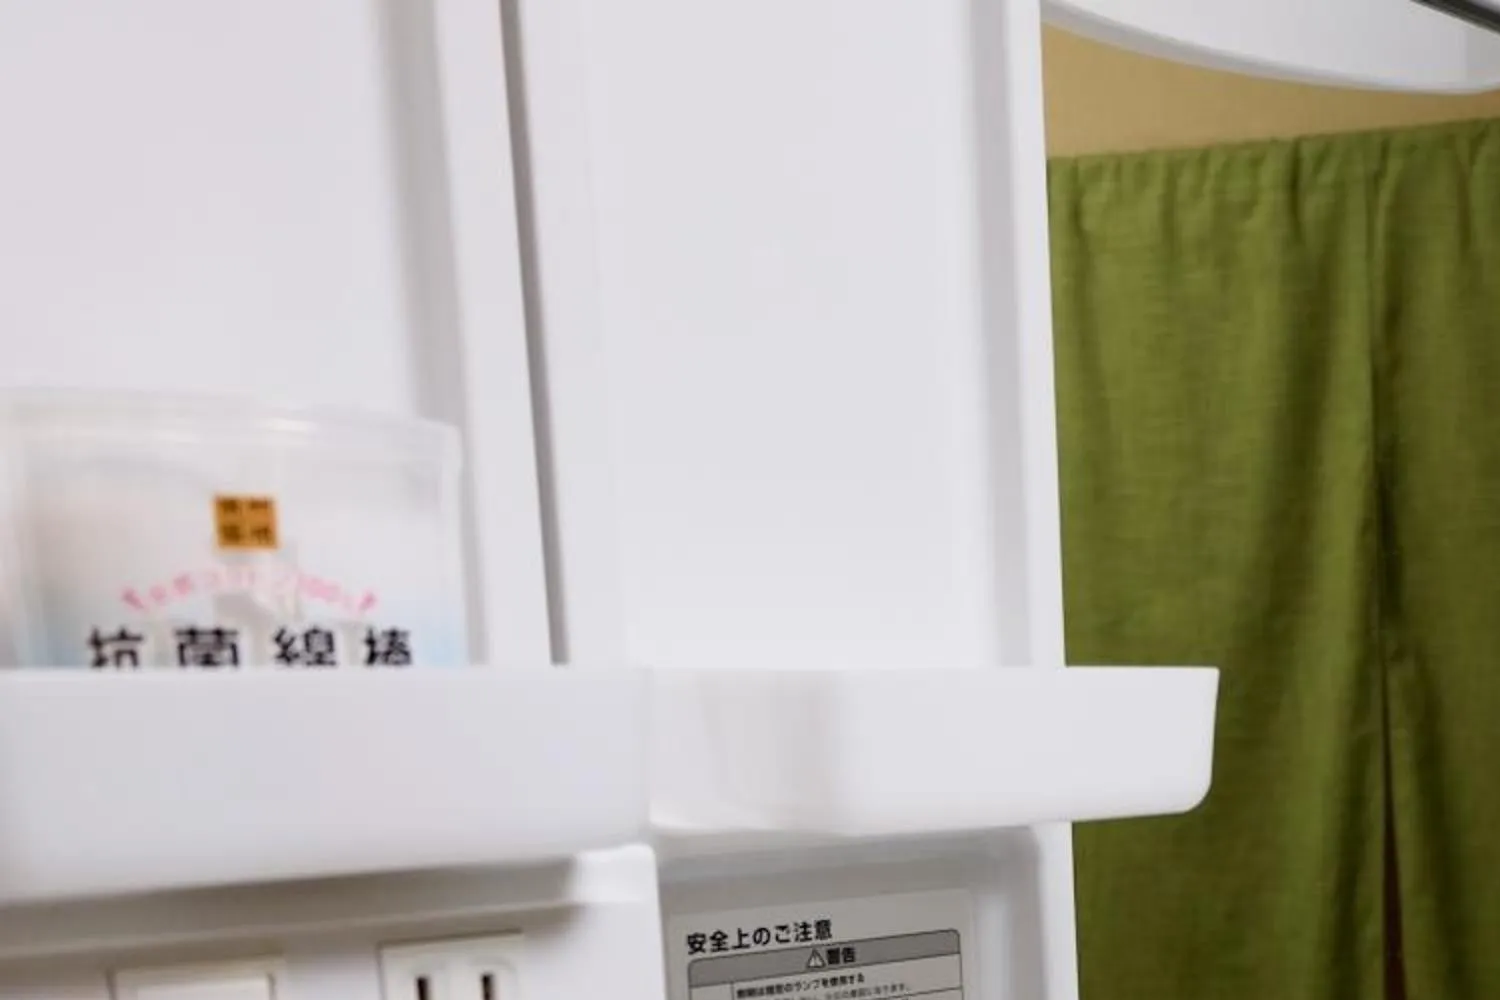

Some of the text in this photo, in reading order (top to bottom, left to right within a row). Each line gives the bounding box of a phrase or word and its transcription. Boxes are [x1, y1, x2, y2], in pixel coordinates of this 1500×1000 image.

[687, 919, 832, 955] 安全上のご注意
